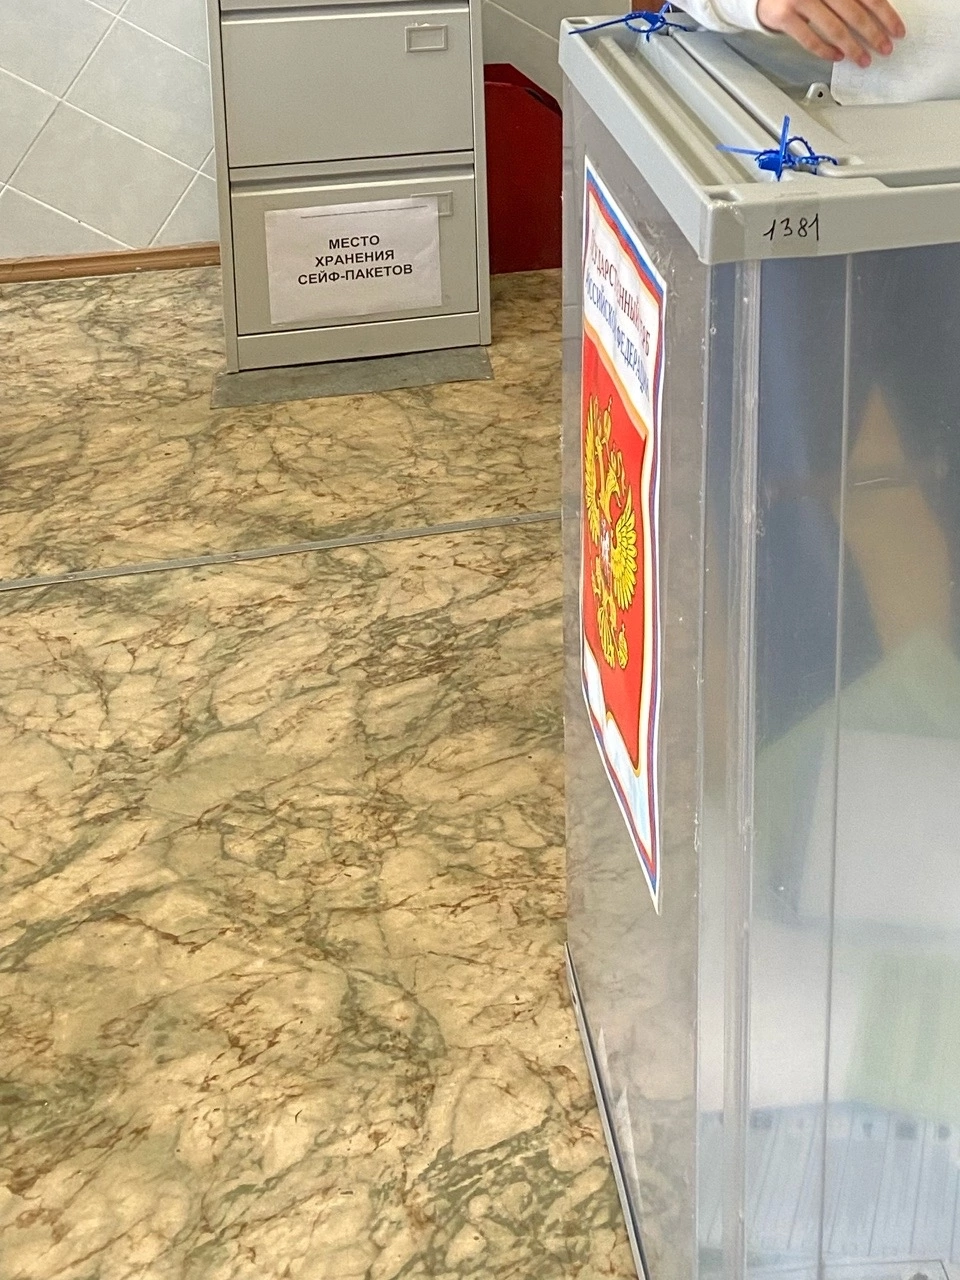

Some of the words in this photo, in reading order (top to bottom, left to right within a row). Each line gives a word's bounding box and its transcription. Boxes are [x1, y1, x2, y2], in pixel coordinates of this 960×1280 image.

[763, 213, 819, 241] 1381
[329, 235, 380, 250] МЕСТО
[315, 249, 395, 267] ХРАНЕНИЯ
[298, 264, 413, 285] СЕЙФ-ПАКЕТОВ
